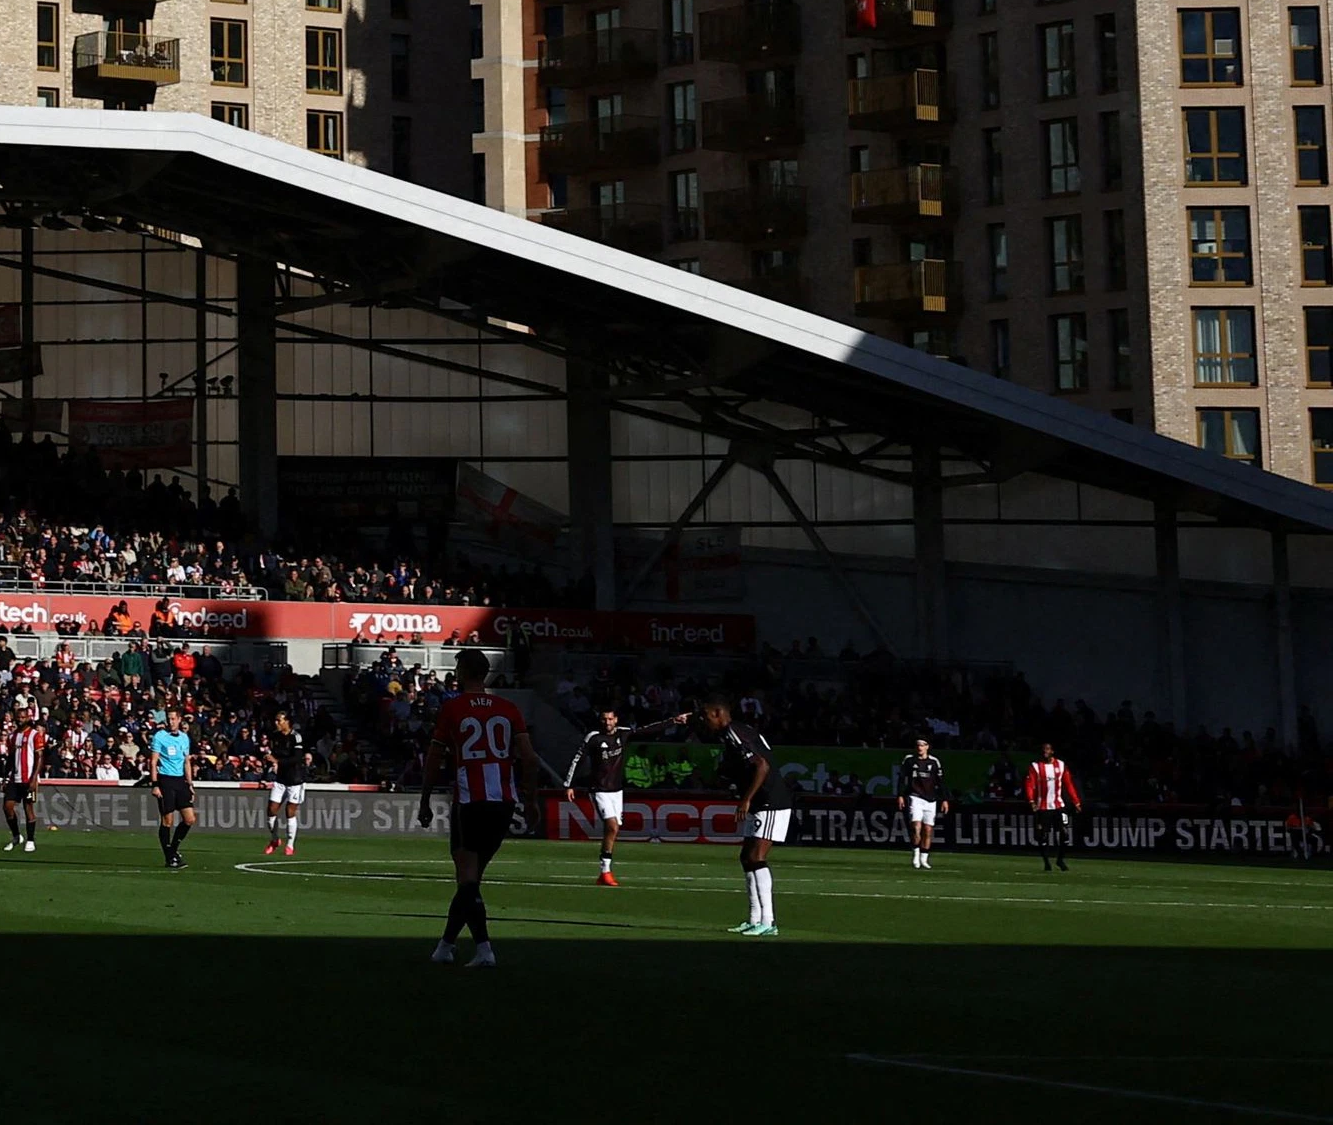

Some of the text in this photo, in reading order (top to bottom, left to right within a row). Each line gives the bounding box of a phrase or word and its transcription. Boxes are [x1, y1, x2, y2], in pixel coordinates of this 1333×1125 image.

[168, 603, 248, 630] indeed
[648, 618, 724, 644] indeed
[459, 715, 512, 760] 20
[754, 819, 762, 833] 9
[1083, 816, 1166, 848] JUMP
